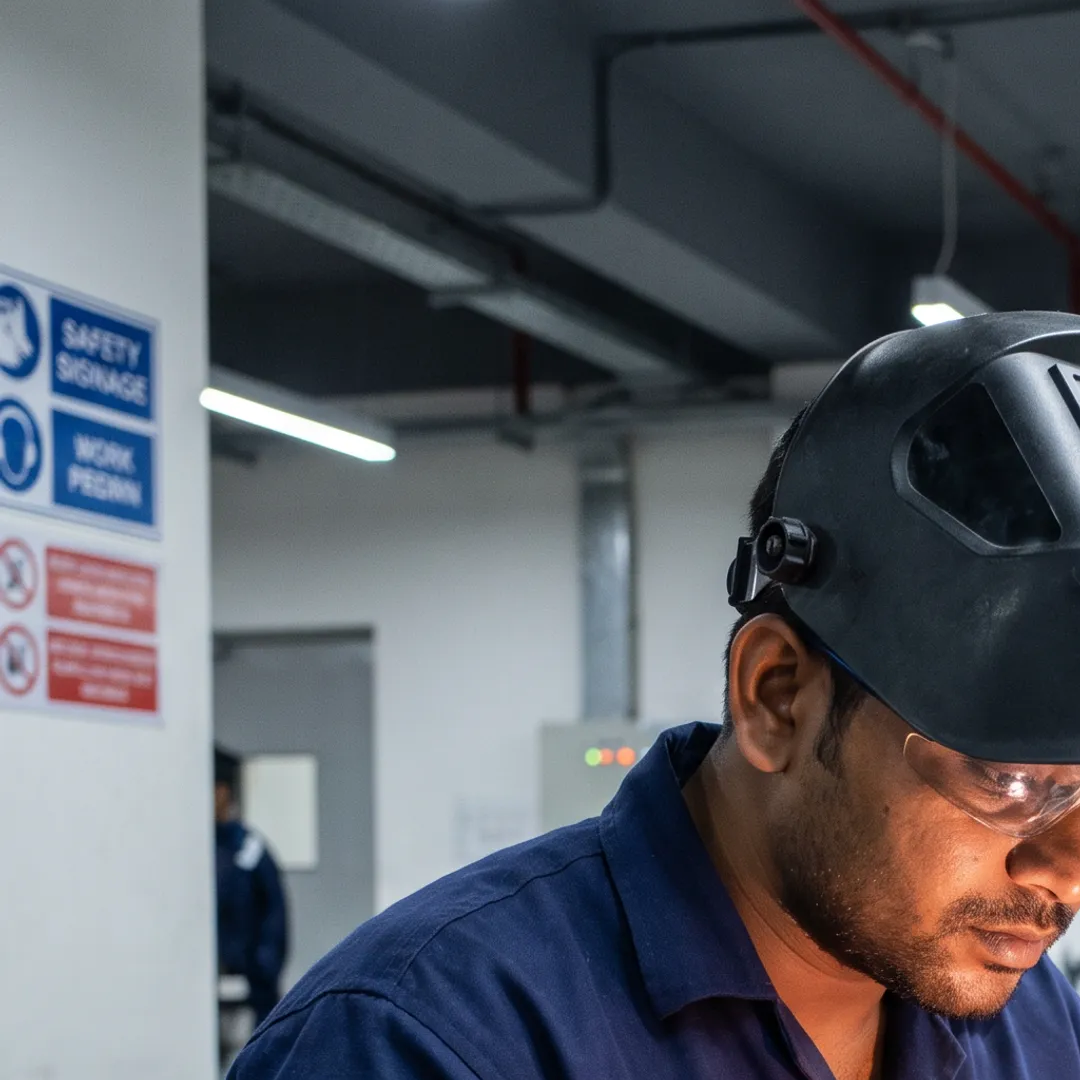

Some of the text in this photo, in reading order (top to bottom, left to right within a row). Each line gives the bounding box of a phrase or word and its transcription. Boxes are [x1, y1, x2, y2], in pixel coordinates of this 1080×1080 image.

[62, 317, 142, 370] SAFETY
[56, 351, 148, 407] SIGNAGE
[73, 432, 137, 475] WORK
